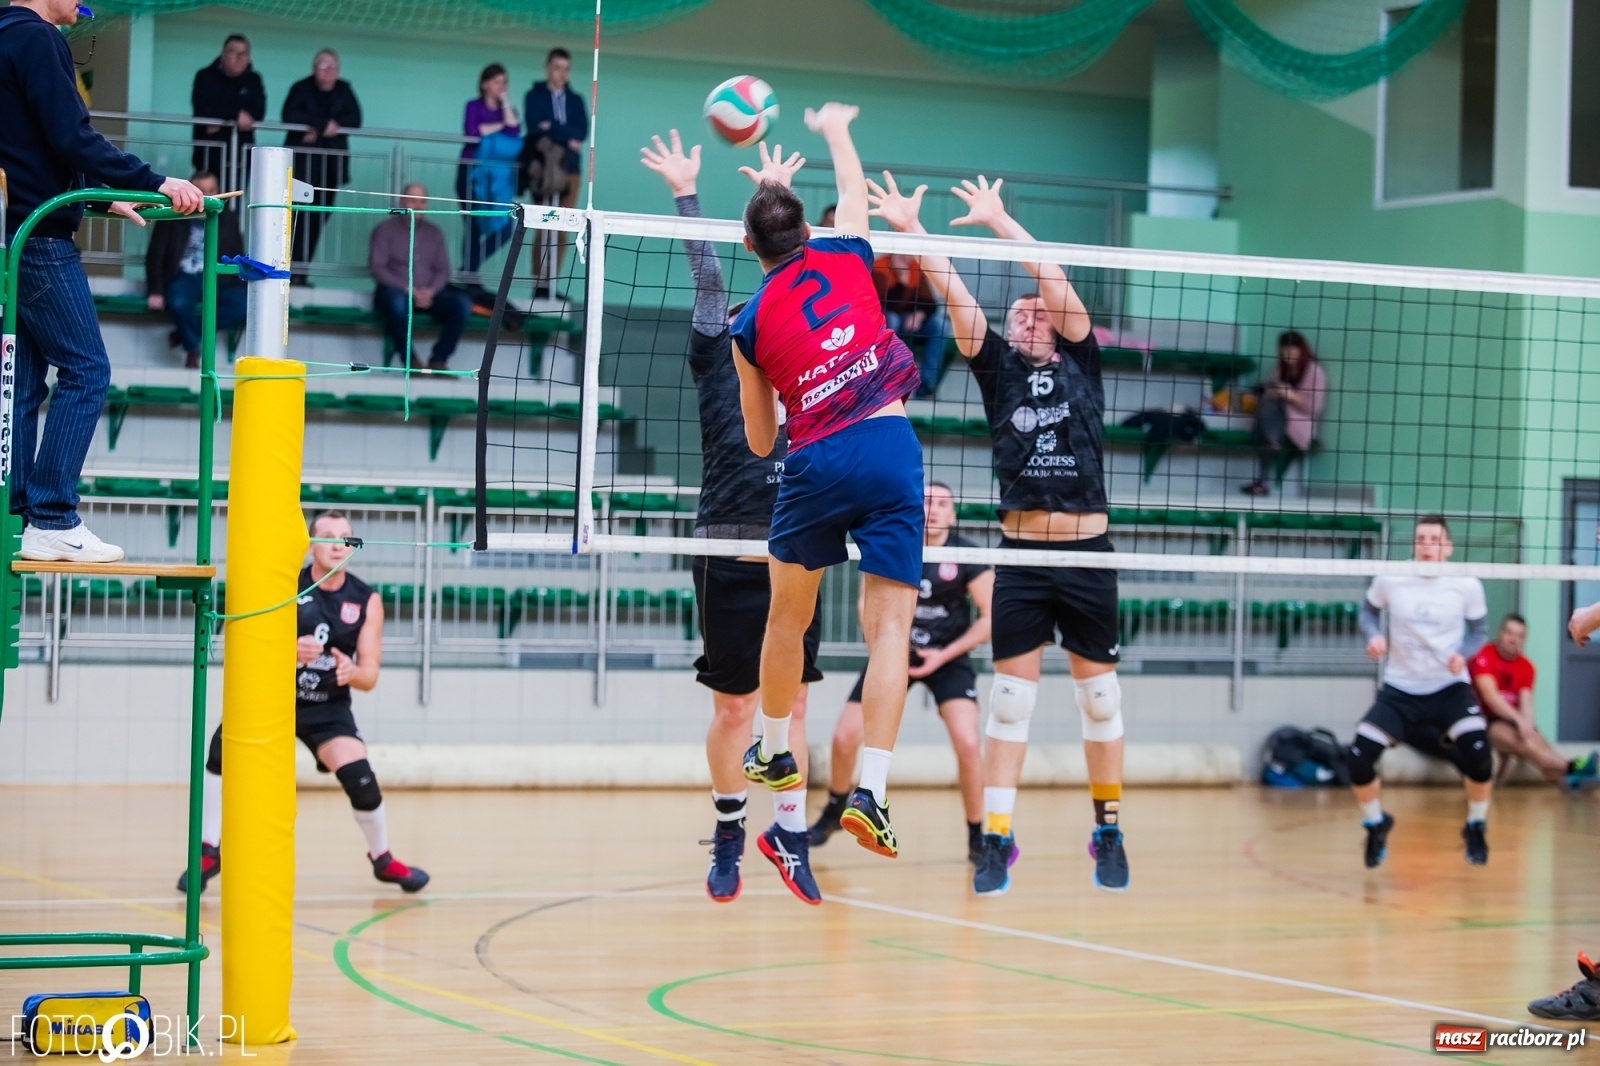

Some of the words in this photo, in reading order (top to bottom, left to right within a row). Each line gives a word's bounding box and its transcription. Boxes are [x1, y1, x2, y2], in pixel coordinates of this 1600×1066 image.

[788, 269, 851, 331] 2
[1027, 370, 1054, 396] 15
[314, 623, 331, 646] 6
